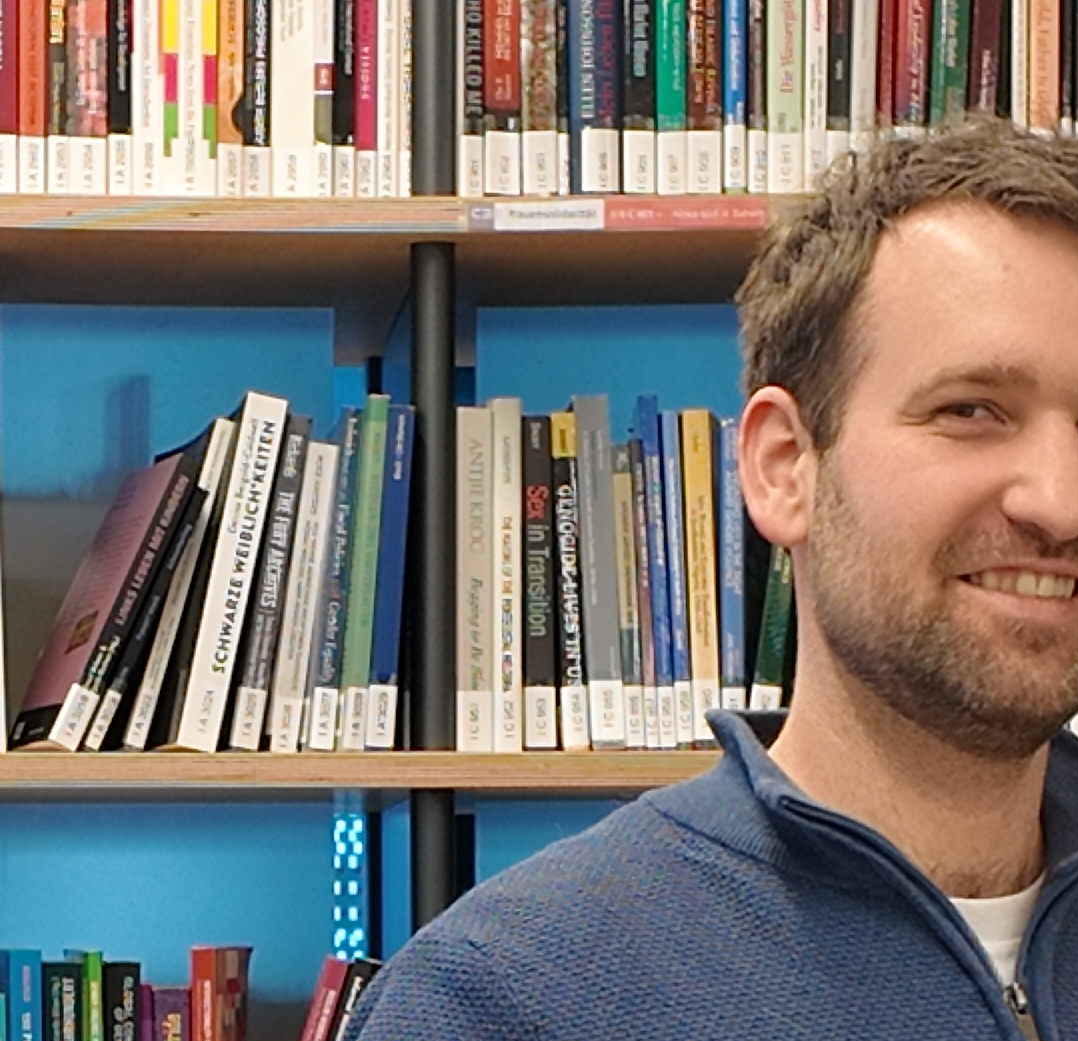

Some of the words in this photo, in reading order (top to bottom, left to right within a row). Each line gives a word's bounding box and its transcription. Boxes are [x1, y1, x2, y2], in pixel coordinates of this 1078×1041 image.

[581, 72, 596, 119] ELLEN
[466, 500, 485, 555] KROG
[526, 485, 550, 520] Sex
[556, 484, 579, 571] GENOCIDE
[527, 523, 550, 542] in
[112, 589, 139, 626] LINKS
[130, 550, 156, 589] LEBEN
[526, 546, 551, 637] Transition
[562, 574, 583, 633] LIVES
[211, 578, 243, 674] SCHWARZE
